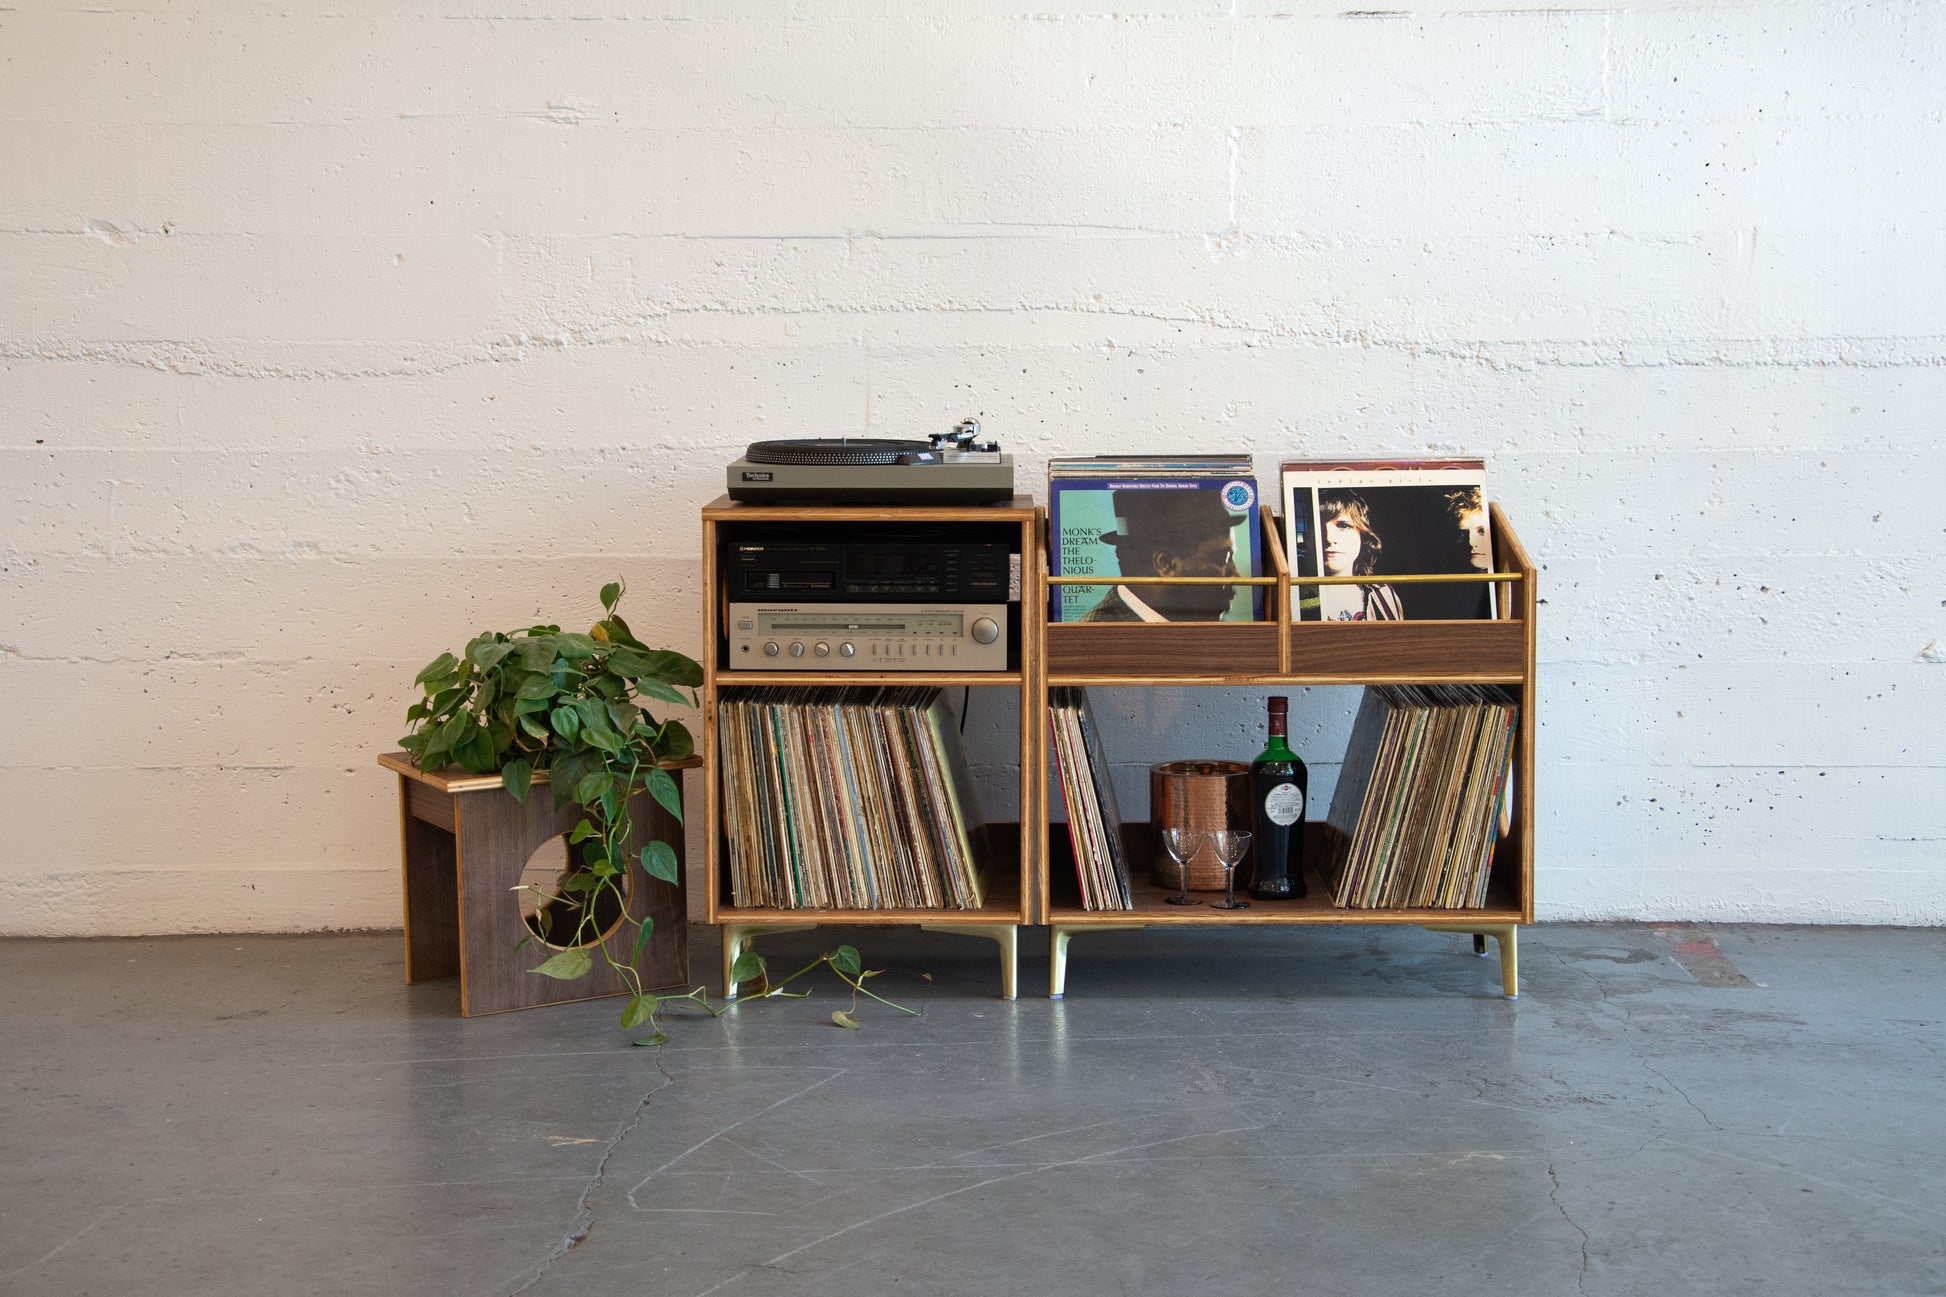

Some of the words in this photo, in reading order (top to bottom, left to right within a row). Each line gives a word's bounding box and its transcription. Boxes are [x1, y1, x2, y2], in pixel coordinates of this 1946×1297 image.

[1062, 527, 1102, 536] MONK'S
[1062, 537, 1098, 546] DREAM
[1062, 547, 1080, 555] THE
[1062, 556, 1097, 565] THELO-
[1062, 566, 1094, 575] NIOUS
[1062, 585, 1096, 594] QUAR-
[1063, 595, 1080, 604] TET
